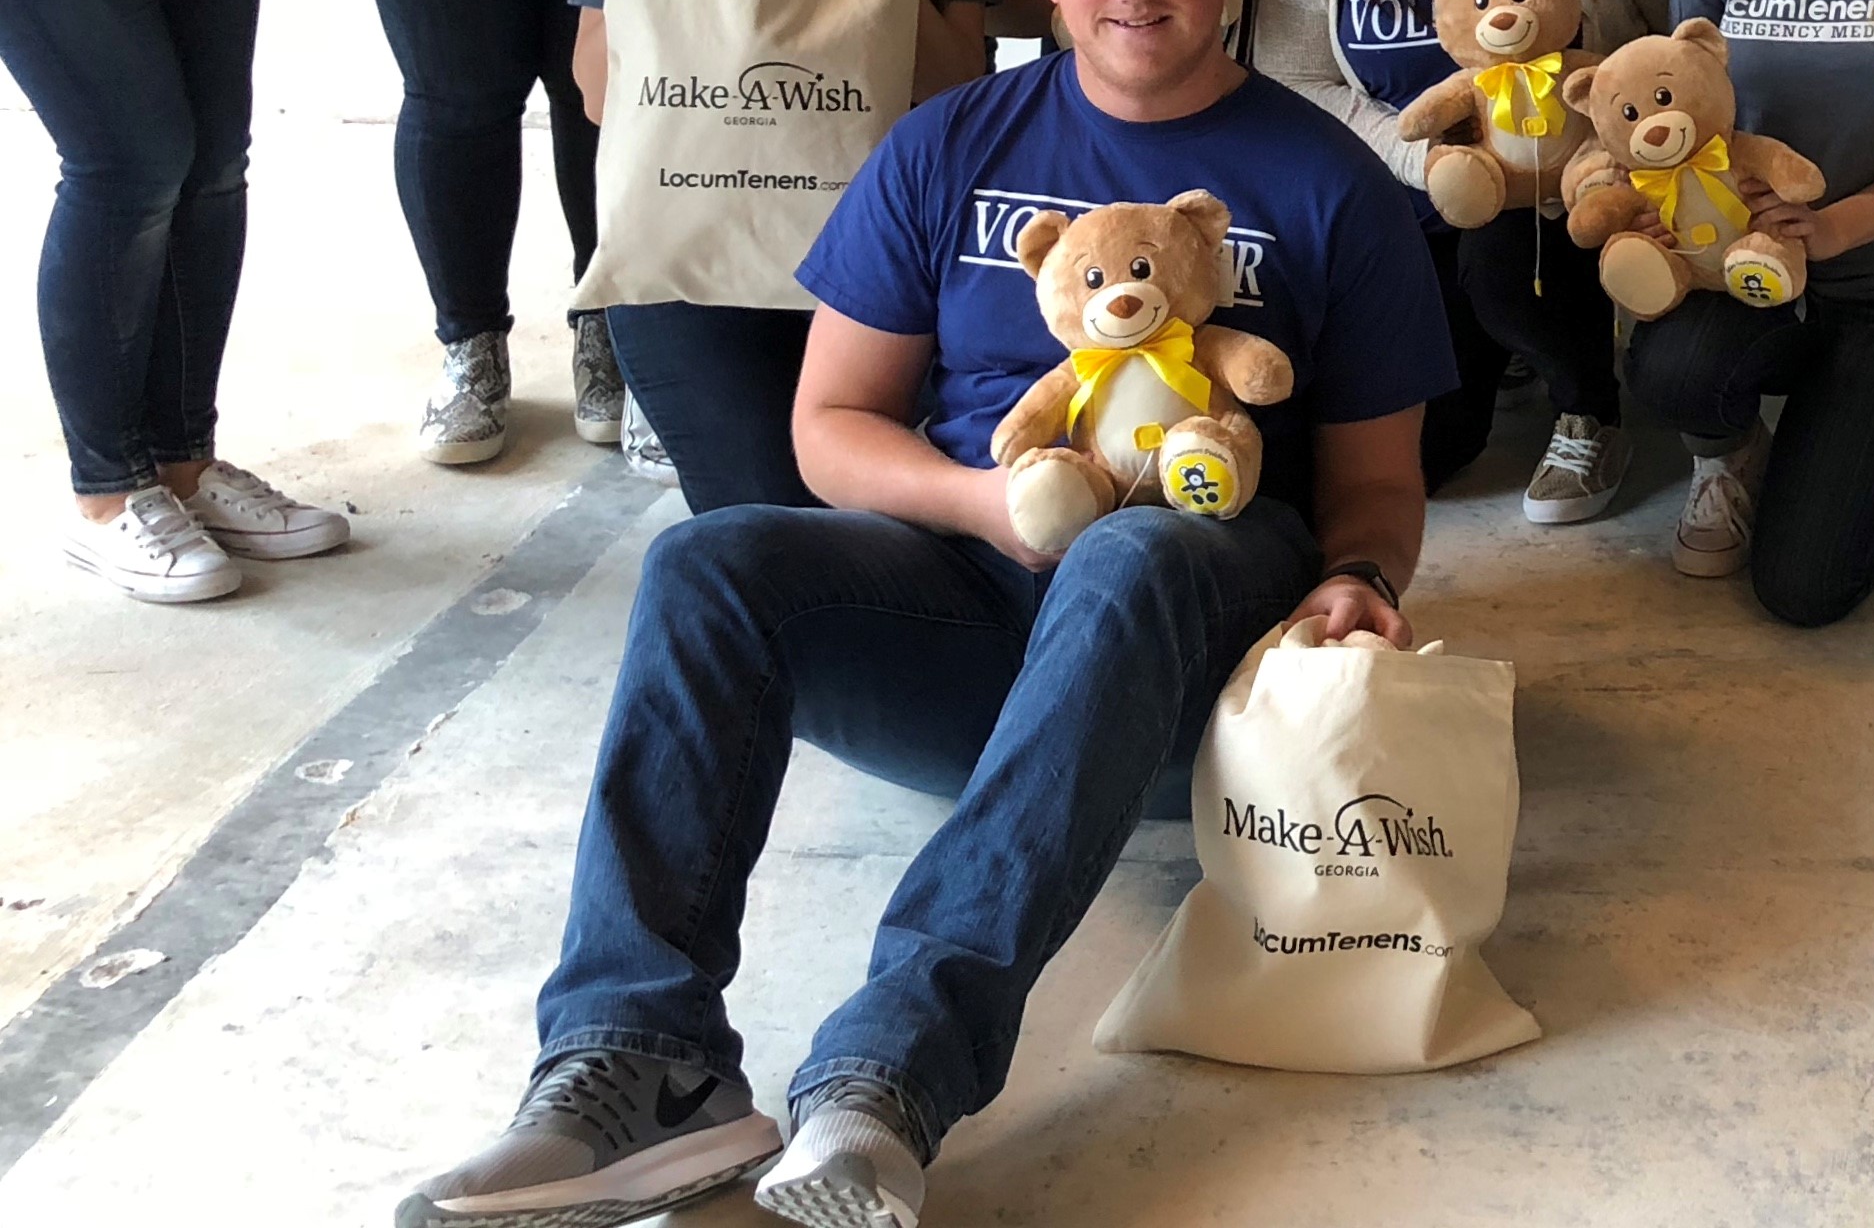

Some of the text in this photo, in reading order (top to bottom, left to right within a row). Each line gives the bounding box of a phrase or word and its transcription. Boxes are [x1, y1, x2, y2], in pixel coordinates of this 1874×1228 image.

[1721, 20, 1826, 39] ERGENCY
[723, 115, 778, 127] GEORGIA
[659, 167, 849, 191] LocumTenens.com
[1313, 863, 1380, 878] GEORGIA
